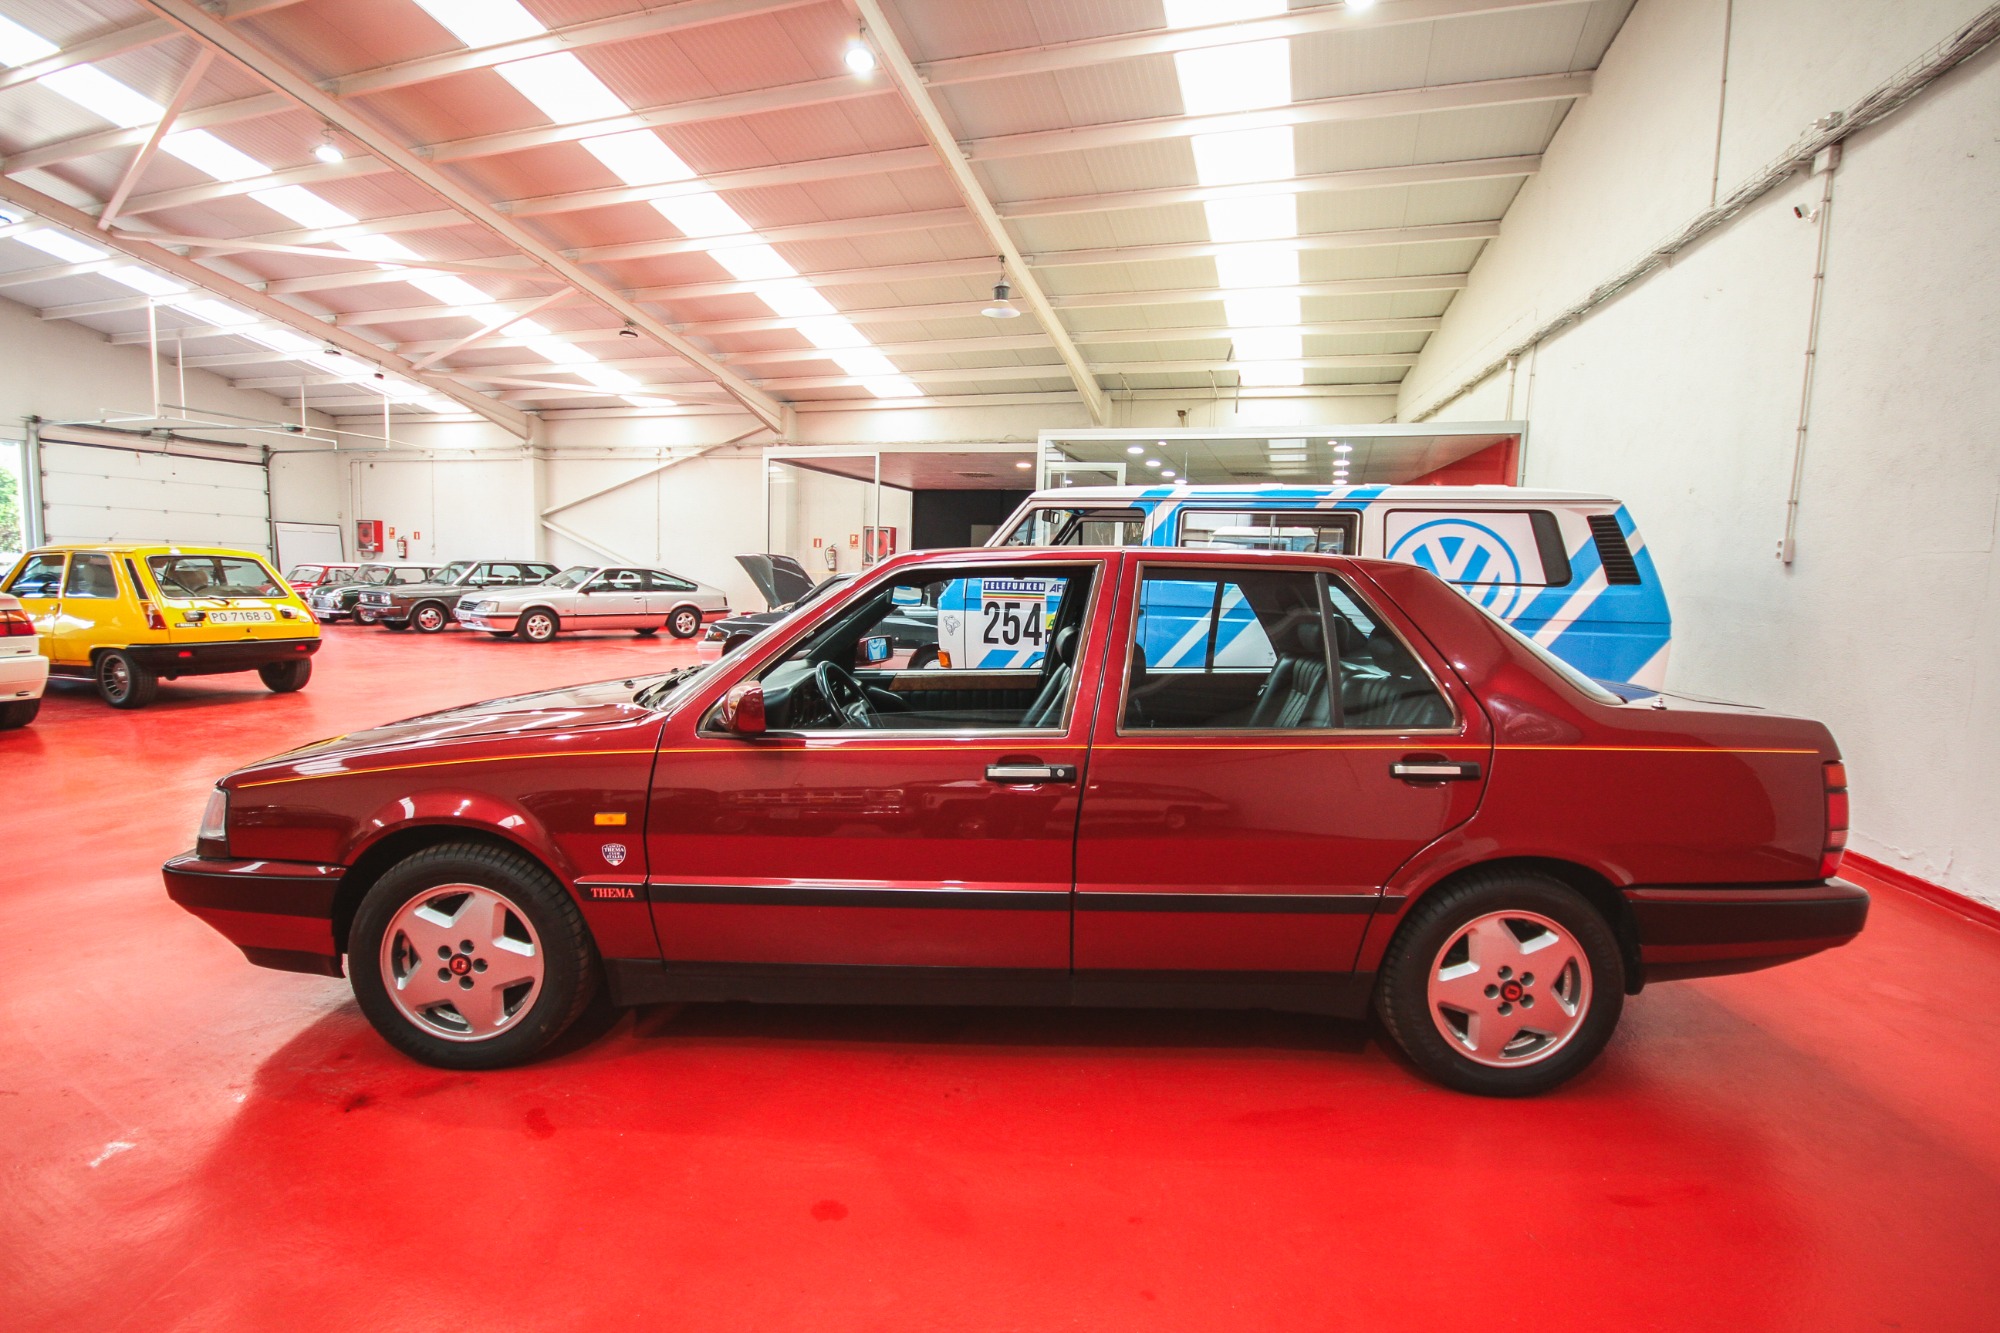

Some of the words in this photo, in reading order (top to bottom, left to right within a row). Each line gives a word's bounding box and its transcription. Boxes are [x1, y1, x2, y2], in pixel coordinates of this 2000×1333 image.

[984, 582, 1045, 591] TELEFUNKEN
[231, 611, 261, 621] 7168
[983, 601, 1042, 646] 254
[591, 887, 634, 898] THEMA
